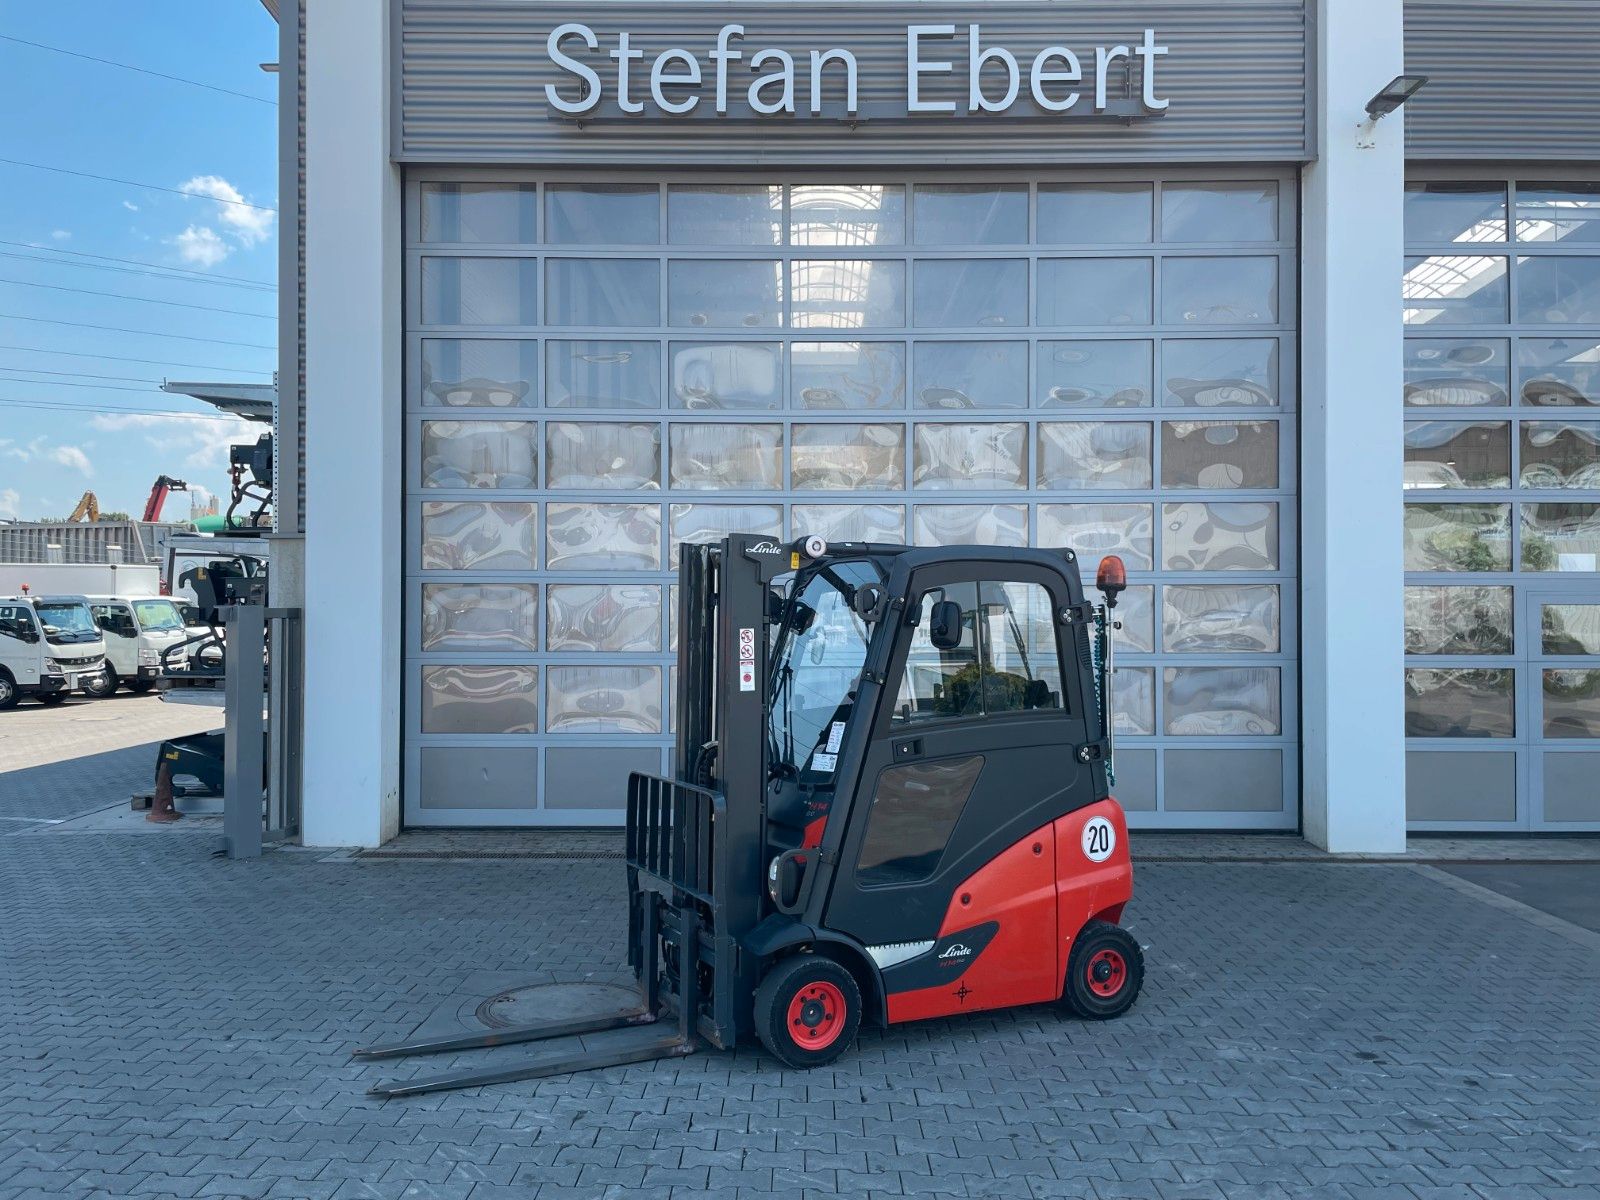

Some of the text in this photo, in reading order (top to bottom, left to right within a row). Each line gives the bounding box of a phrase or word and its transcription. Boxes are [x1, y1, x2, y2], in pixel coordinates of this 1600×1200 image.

[544, 23, 1170, 114] Stefan Ebert
[745, 541, 782, 555] Linde
[1088, 824, 1109, 854] 20
[938, 943, 972, 958] Linde
